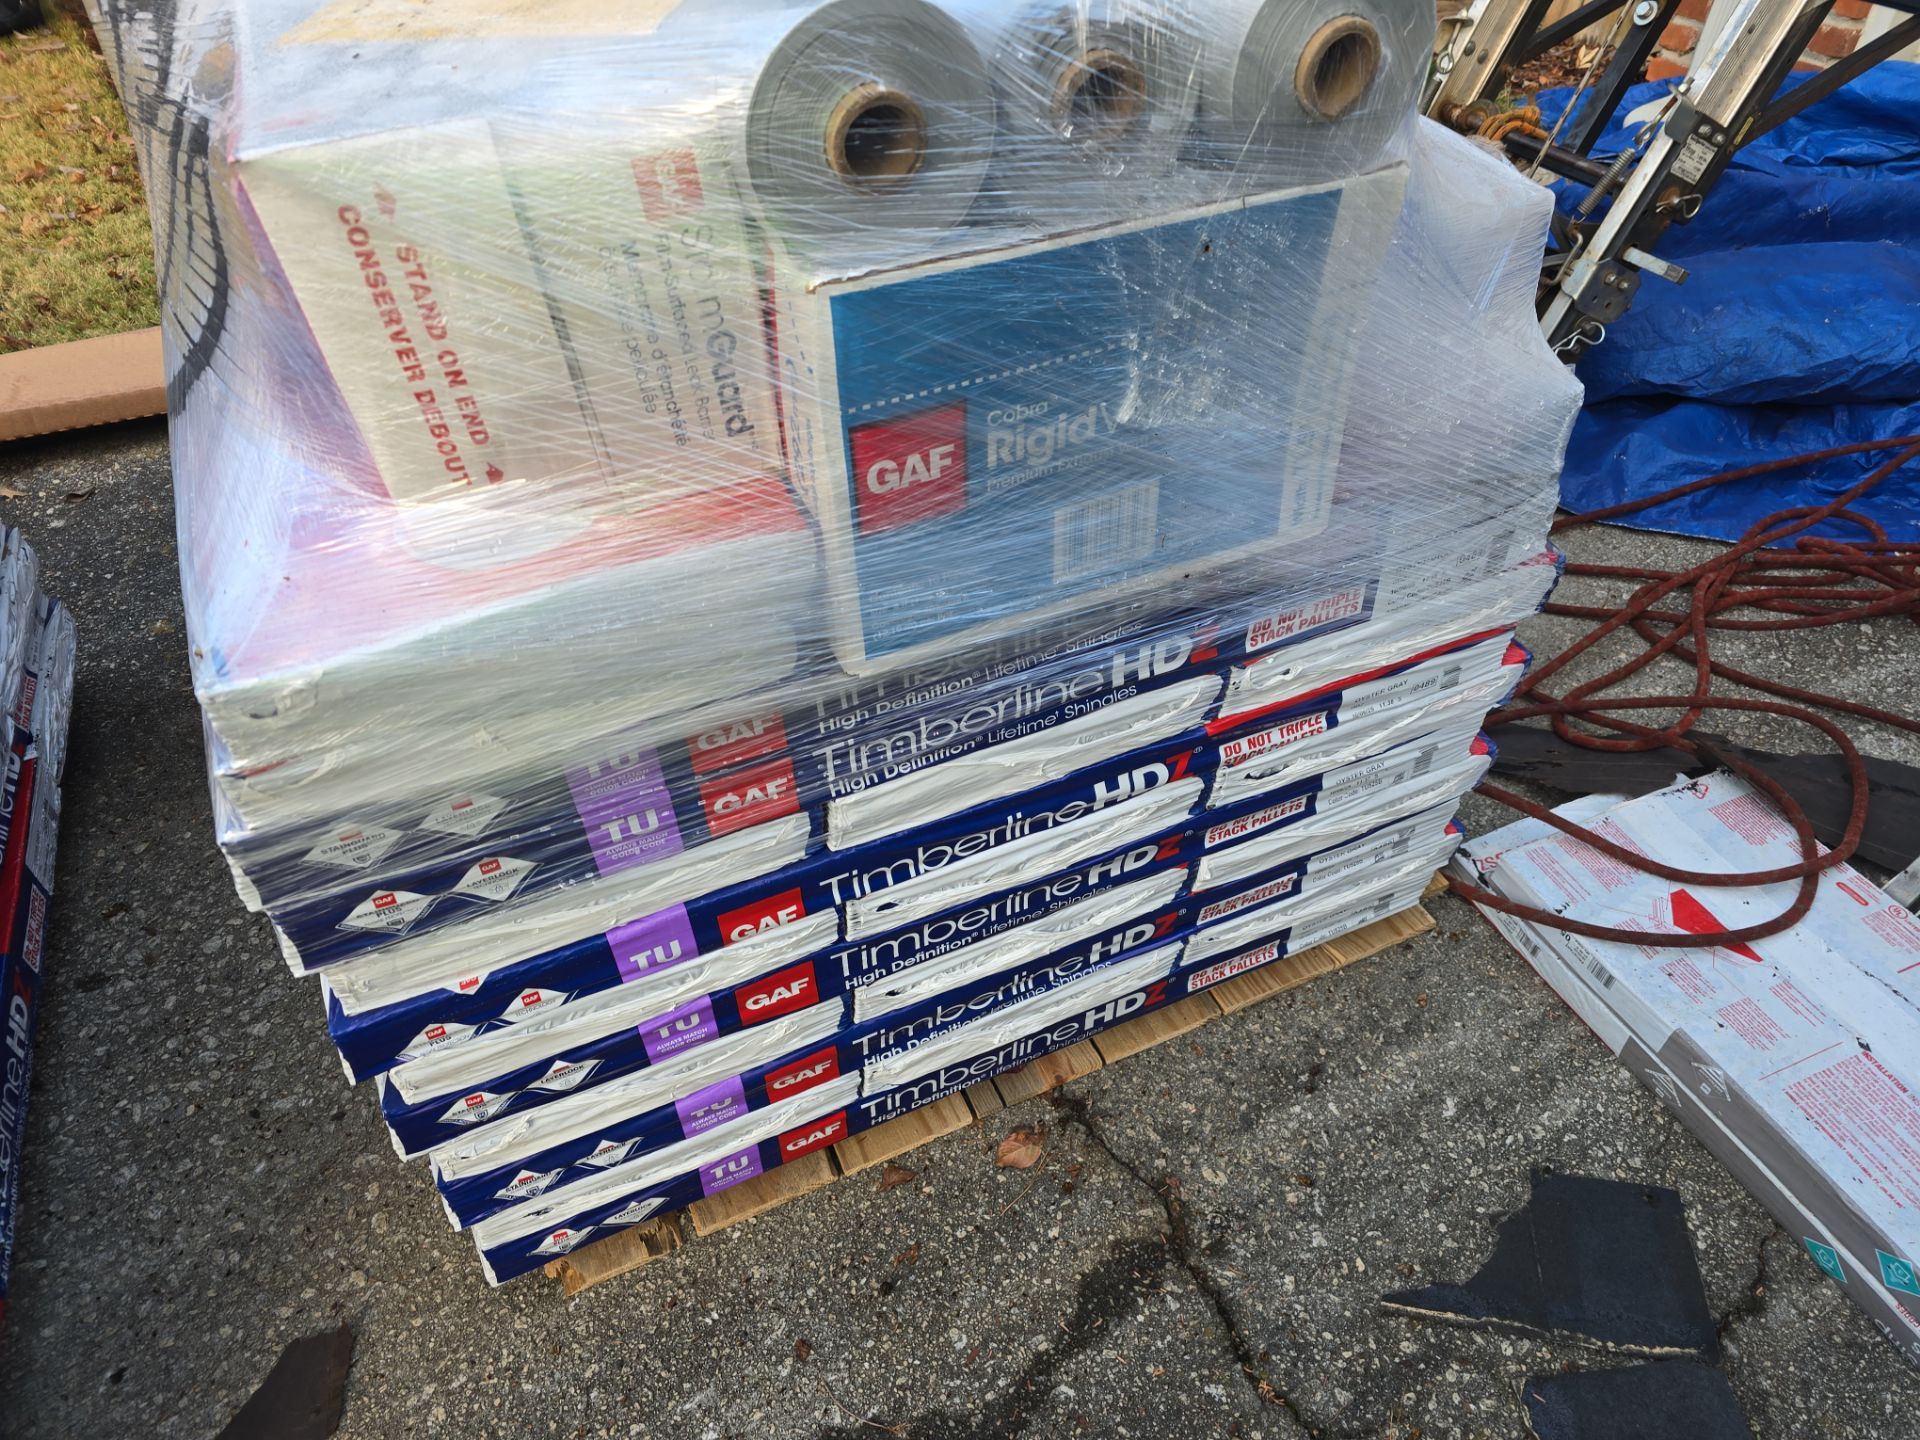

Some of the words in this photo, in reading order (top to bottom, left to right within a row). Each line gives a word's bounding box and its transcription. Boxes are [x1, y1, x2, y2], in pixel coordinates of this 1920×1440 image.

[337, 204, 427, 384] CONSERVER
[413, 388, 474, 487] DEBOUT
[396, 244, 449, 343] STAND
[437, 349, 469, 390] ON
[455, 394, 491, 447] END
[987, 401, 1050, 427] Cobra
[867, 444, 956, 495] GAF
[1249, 624, 1295, 649] STACK
[1299, 600, 1360, 632] PALLETS
[1251, 618, 1273, 636] DO
[1277, 608, 1306, 627] NOT
[1312, 587, 1362, 616] TRIPLE
[696, 713, 778, 751] GAF
[813, 667, 1105, 783] Timberline
[819, 708, 871, 736] High
[1223, 741, 1243, 758] DO
[1247, 731, 1273, 750] NOT
[1278, 713, 1323, 739] TRIPLE
[829, 772, 879, 800] High
[1064, 683, 1138, 721] Shingles
[1366, 761, 1386, 775] GRAY
[713, 776, 789, 815] GAF
[601, 808, 660, 844] TU
[1208, 822, 1249, 844] STACK
[1251, 801, 1303, 828] PALLETS
[481, 861, 500, 874] GAF
[820, 799, 1087, 906] Timberline
[374, 893, 395, 907] GAF
[375, 906, 404, 920] PLUS
[1201, 903, 1238, 921] STACK
[1241, 883, 1289, 907] PALLETS
[1203, 903, 1220, 915] DO
[730, 903, 799, 944] GAF
[831, 873, 1083, 978] Timberline
[844, 964, 888, 991] High
[1049, 883, 1114, 911] Shingles
[629, 938, 683, 972] TU
[1191, 970, 1227, 990] STACK
[1229, 948, 1275, 975] PALLETS
[1192, 969, 1208, 981] DO
[1212, 959, 1235, 973] NOT
[523, 994, 541, 1005] GAF
[745, 976, 810, 1011] GAF
[852, 954, 1085, 1057] Timberline
[6, 972, 33, 1060] HDZ
[655, 1012, 701, 1040] TU
[864, 1047, 902, 1067] High
[1050, 960, 1113, 990] Shingles
[427, 1027, 445, 1038] GAF
[656, 1036, 684, 1052] ALWAYS
[683, 1027, 709, 1042] MATCH
[772, 1059, 833, 1091] GAF
[860, 1021, 1080, 1119] Timberline
[871, 1106, 908, 1127] High
[1048, 1025, 1105, 1052] Shingles
[1862, 1050, 1909, 1094] INSTALLATION
[467, 1096, 483, 1106] GAF
[690, 1096, 734, 1119] TU
[691, 1113, 713, 1129] ALWAYS
[711, 1104, 739, 1120] MATCH
[717, 1110, 738, 1124] CODE
[786, 1121, 842, 1152] GAF
[710, 1154, 750, 1181] TU
[710, 1174, 734, 1188] ALWAYS
